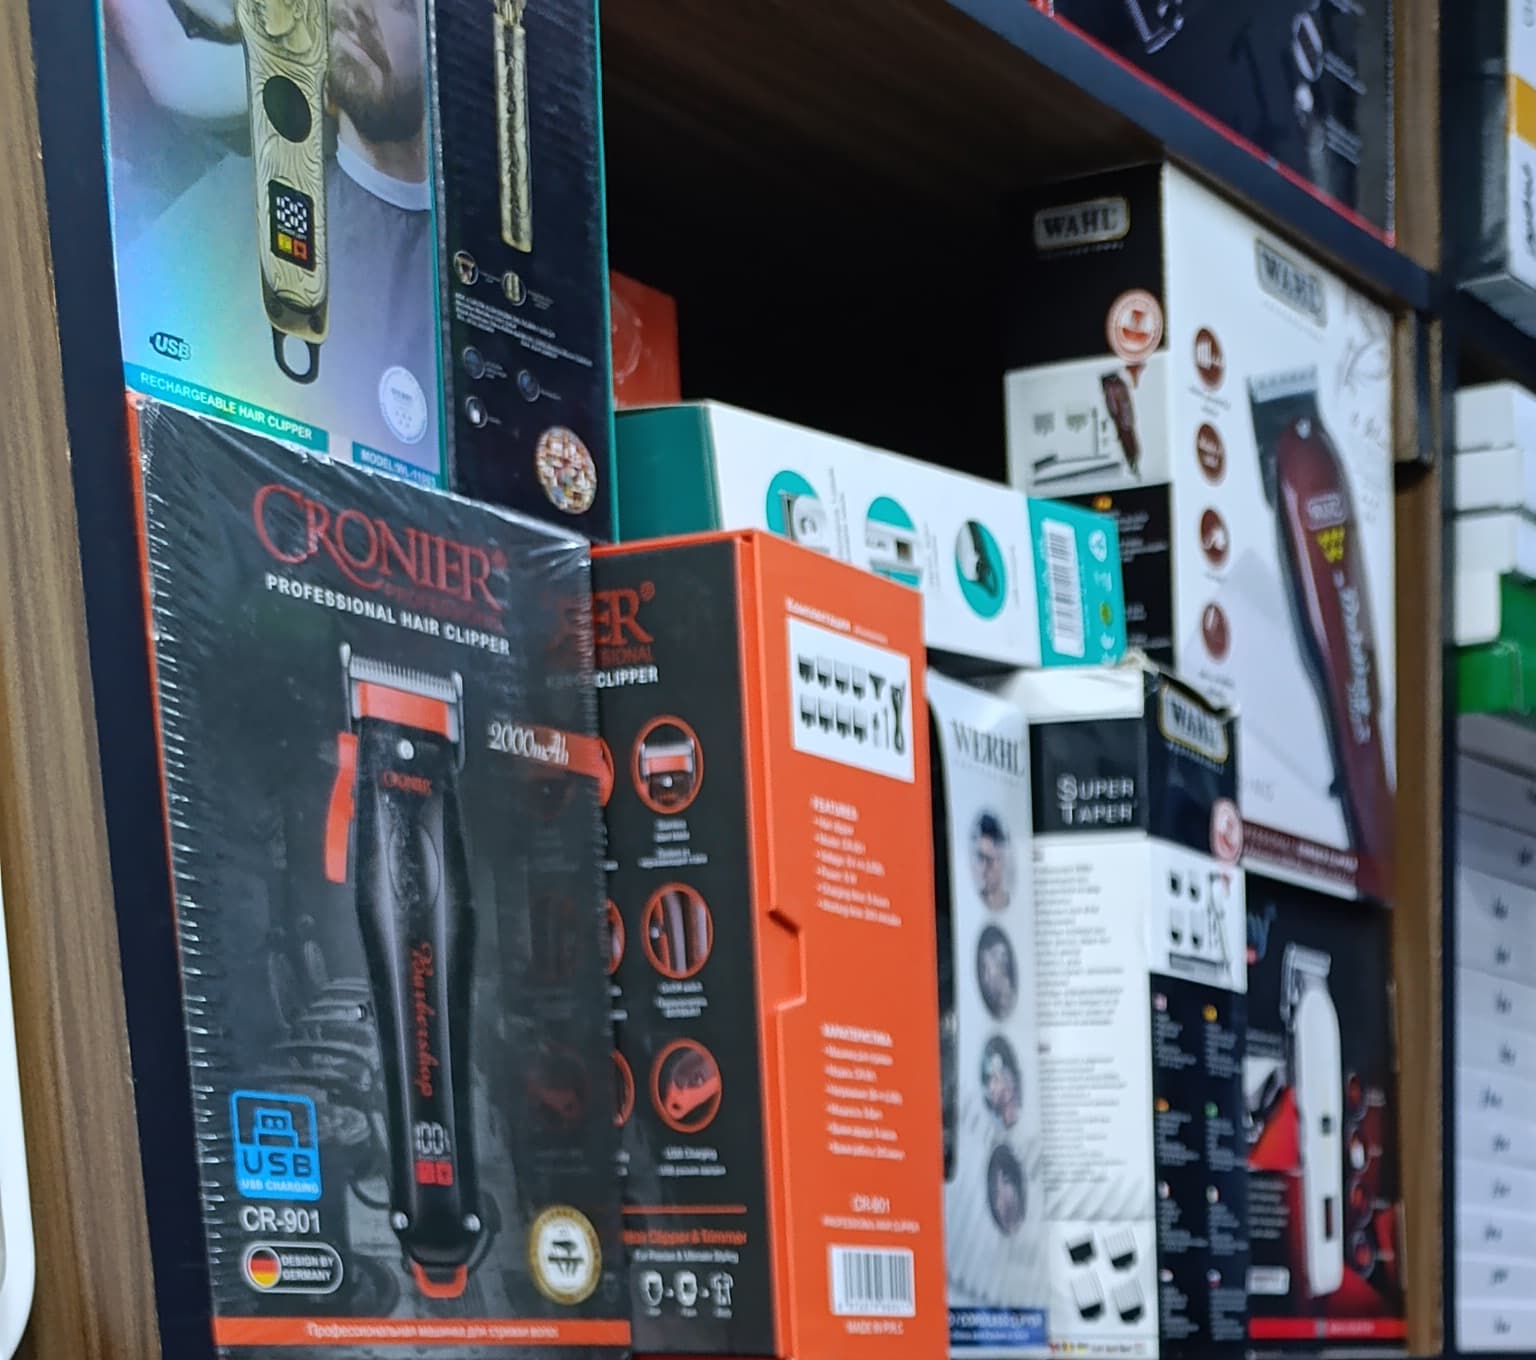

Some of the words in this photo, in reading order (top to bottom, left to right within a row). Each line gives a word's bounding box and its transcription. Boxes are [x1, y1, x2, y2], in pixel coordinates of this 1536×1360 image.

[1041, 207, 1119, 240] WAHL
[155, 334, 191, 361] USB
[140, 371, 237, 415] RECHARGEABLE
[238, 403, 266, 424] HAIR
[267, 414, 312, 441] CLIPPER
[252, 483, 499, 610] CRONIER
[264, 572, 397, 627] PROFESSIONAL
[400, 609, 443, 640] HAIR
[445, 624, 511, 657] CLIPPER
[594, 665, 659, 689] CLIPPER
[488, 719, 570, 767] 2000mAh
[243, 1149, 313, 1180] USB
[241, 1206, 321, 1235] CR-901
[281, 1253, 316, 1268] DESIGN
[317, 1254, 335, 1268] BY
[282, 1268, 332, 1282] GERMANY
